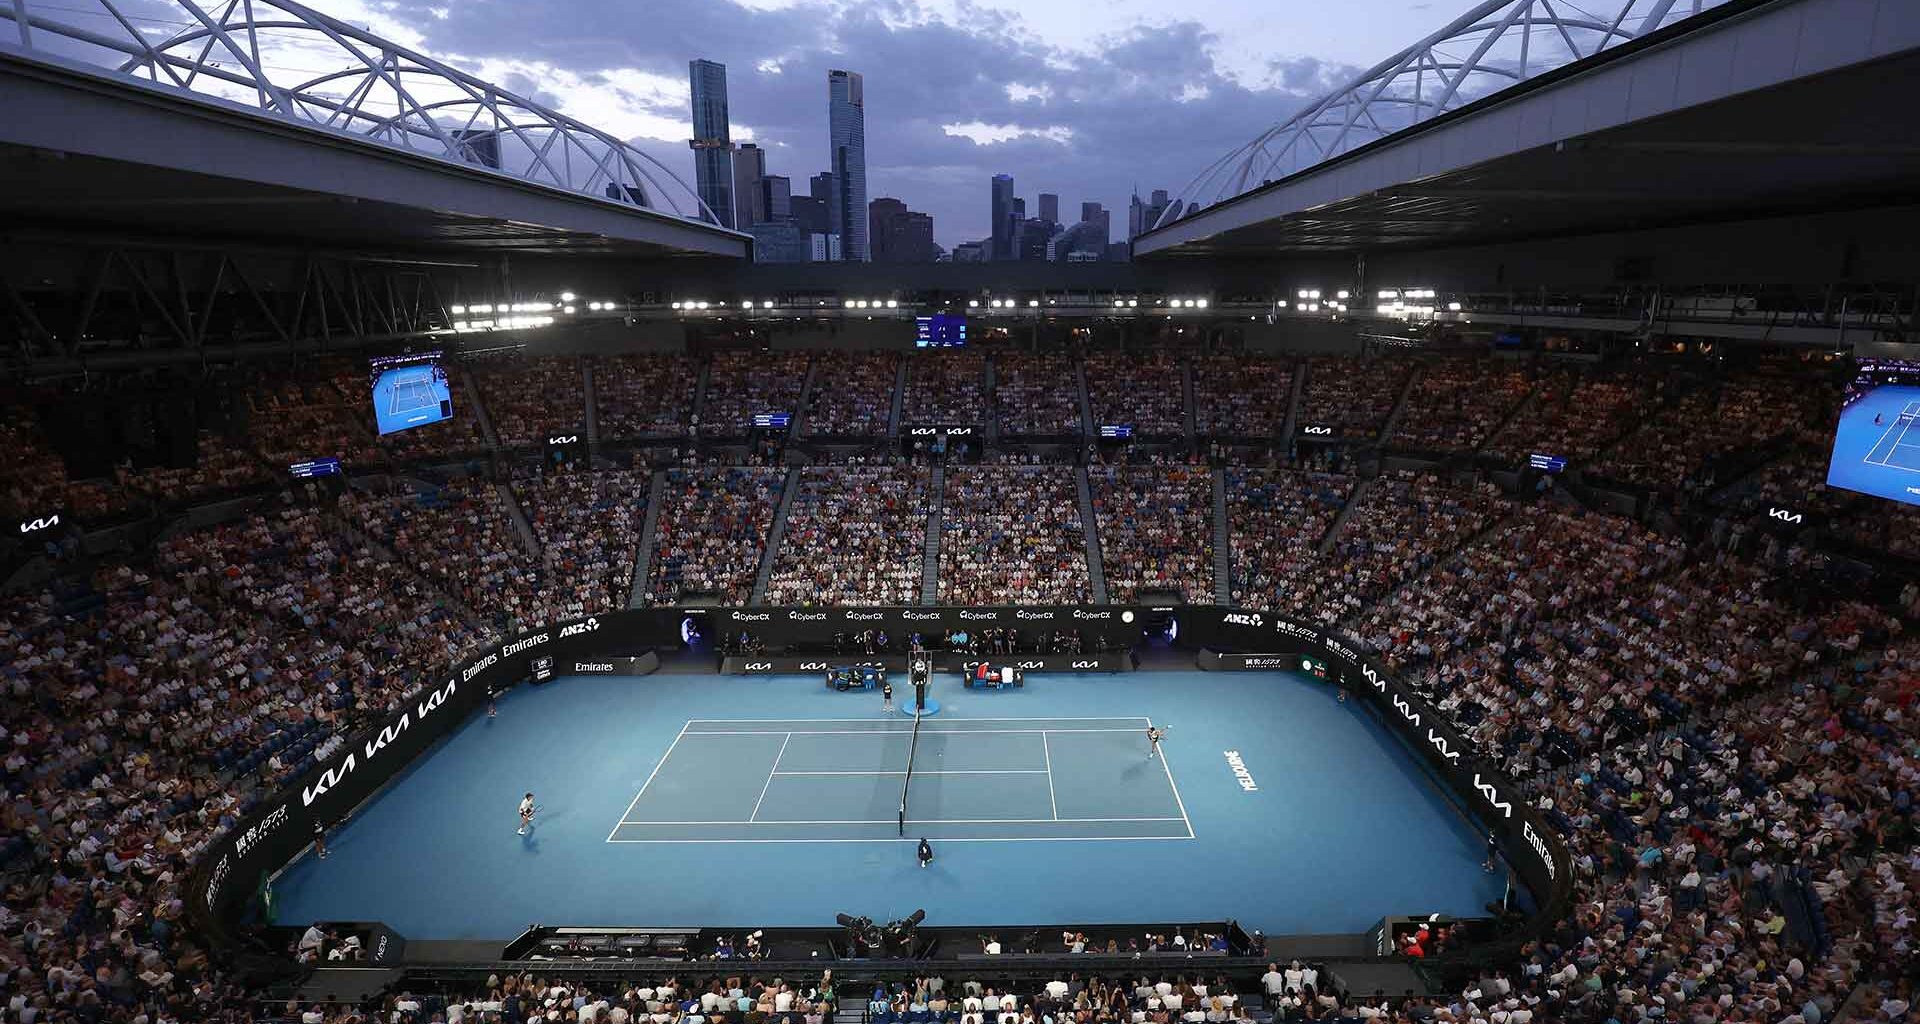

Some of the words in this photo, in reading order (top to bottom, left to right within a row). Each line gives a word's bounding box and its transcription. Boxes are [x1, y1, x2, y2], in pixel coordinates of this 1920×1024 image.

[740, 613, 770, 621] CyberCX
[854, 612, 883, 620] CyberCX
[911, 612, 940, 620] CyberCX
[967, 612, 997, 620] CyberCX
[1024, 612, 1053, 620] CyberCX
[1081, 612, 1110, 620] CyberCX
[1224, 614, 1249, 625] ANZ
[559, 622, 586, 638] ANZ
[462, 652, 498, 682] Emirates
[502, 632, 549, 657] Emirates
[575, 662, 613, 672] Emirates
[1223, 750, 1258, 791] MELBOURNE
[1523, 821, 1555, 879] Emirates
